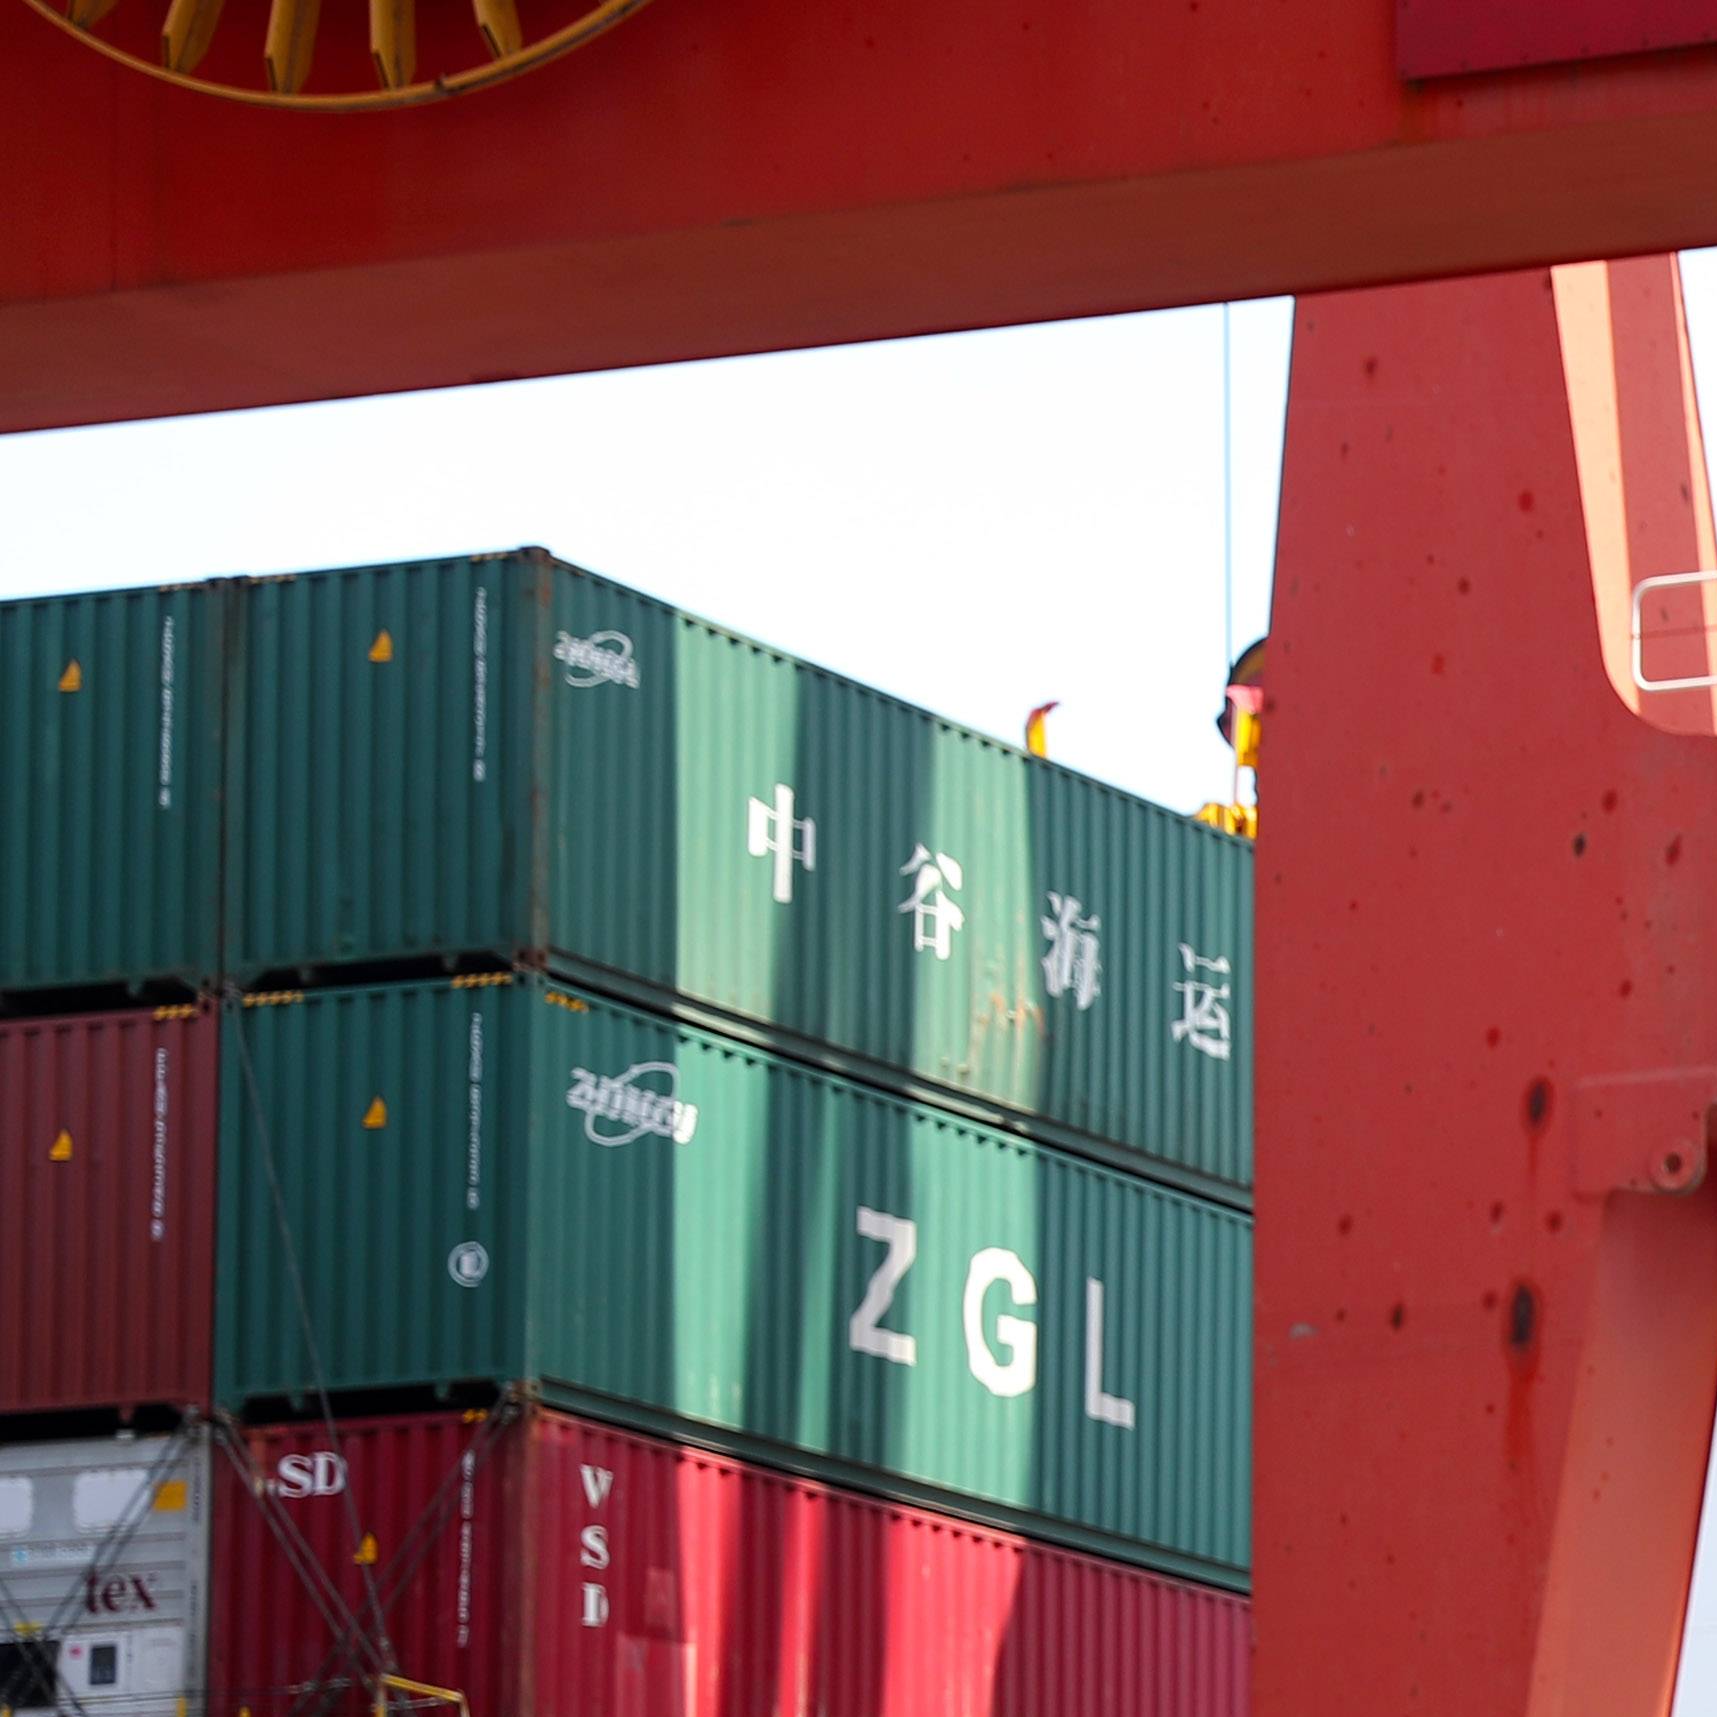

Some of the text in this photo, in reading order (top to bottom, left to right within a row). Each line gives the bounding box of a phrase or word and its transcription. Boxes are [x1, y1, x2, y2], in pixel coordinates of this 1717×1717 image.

[747, 783, 1232, 1060] 中谷海运
[848, 1205, 1137, 1431] ZGL
[262, 1451, 348, 1499] SD
[580, 1463, 614, 1628] VSD
